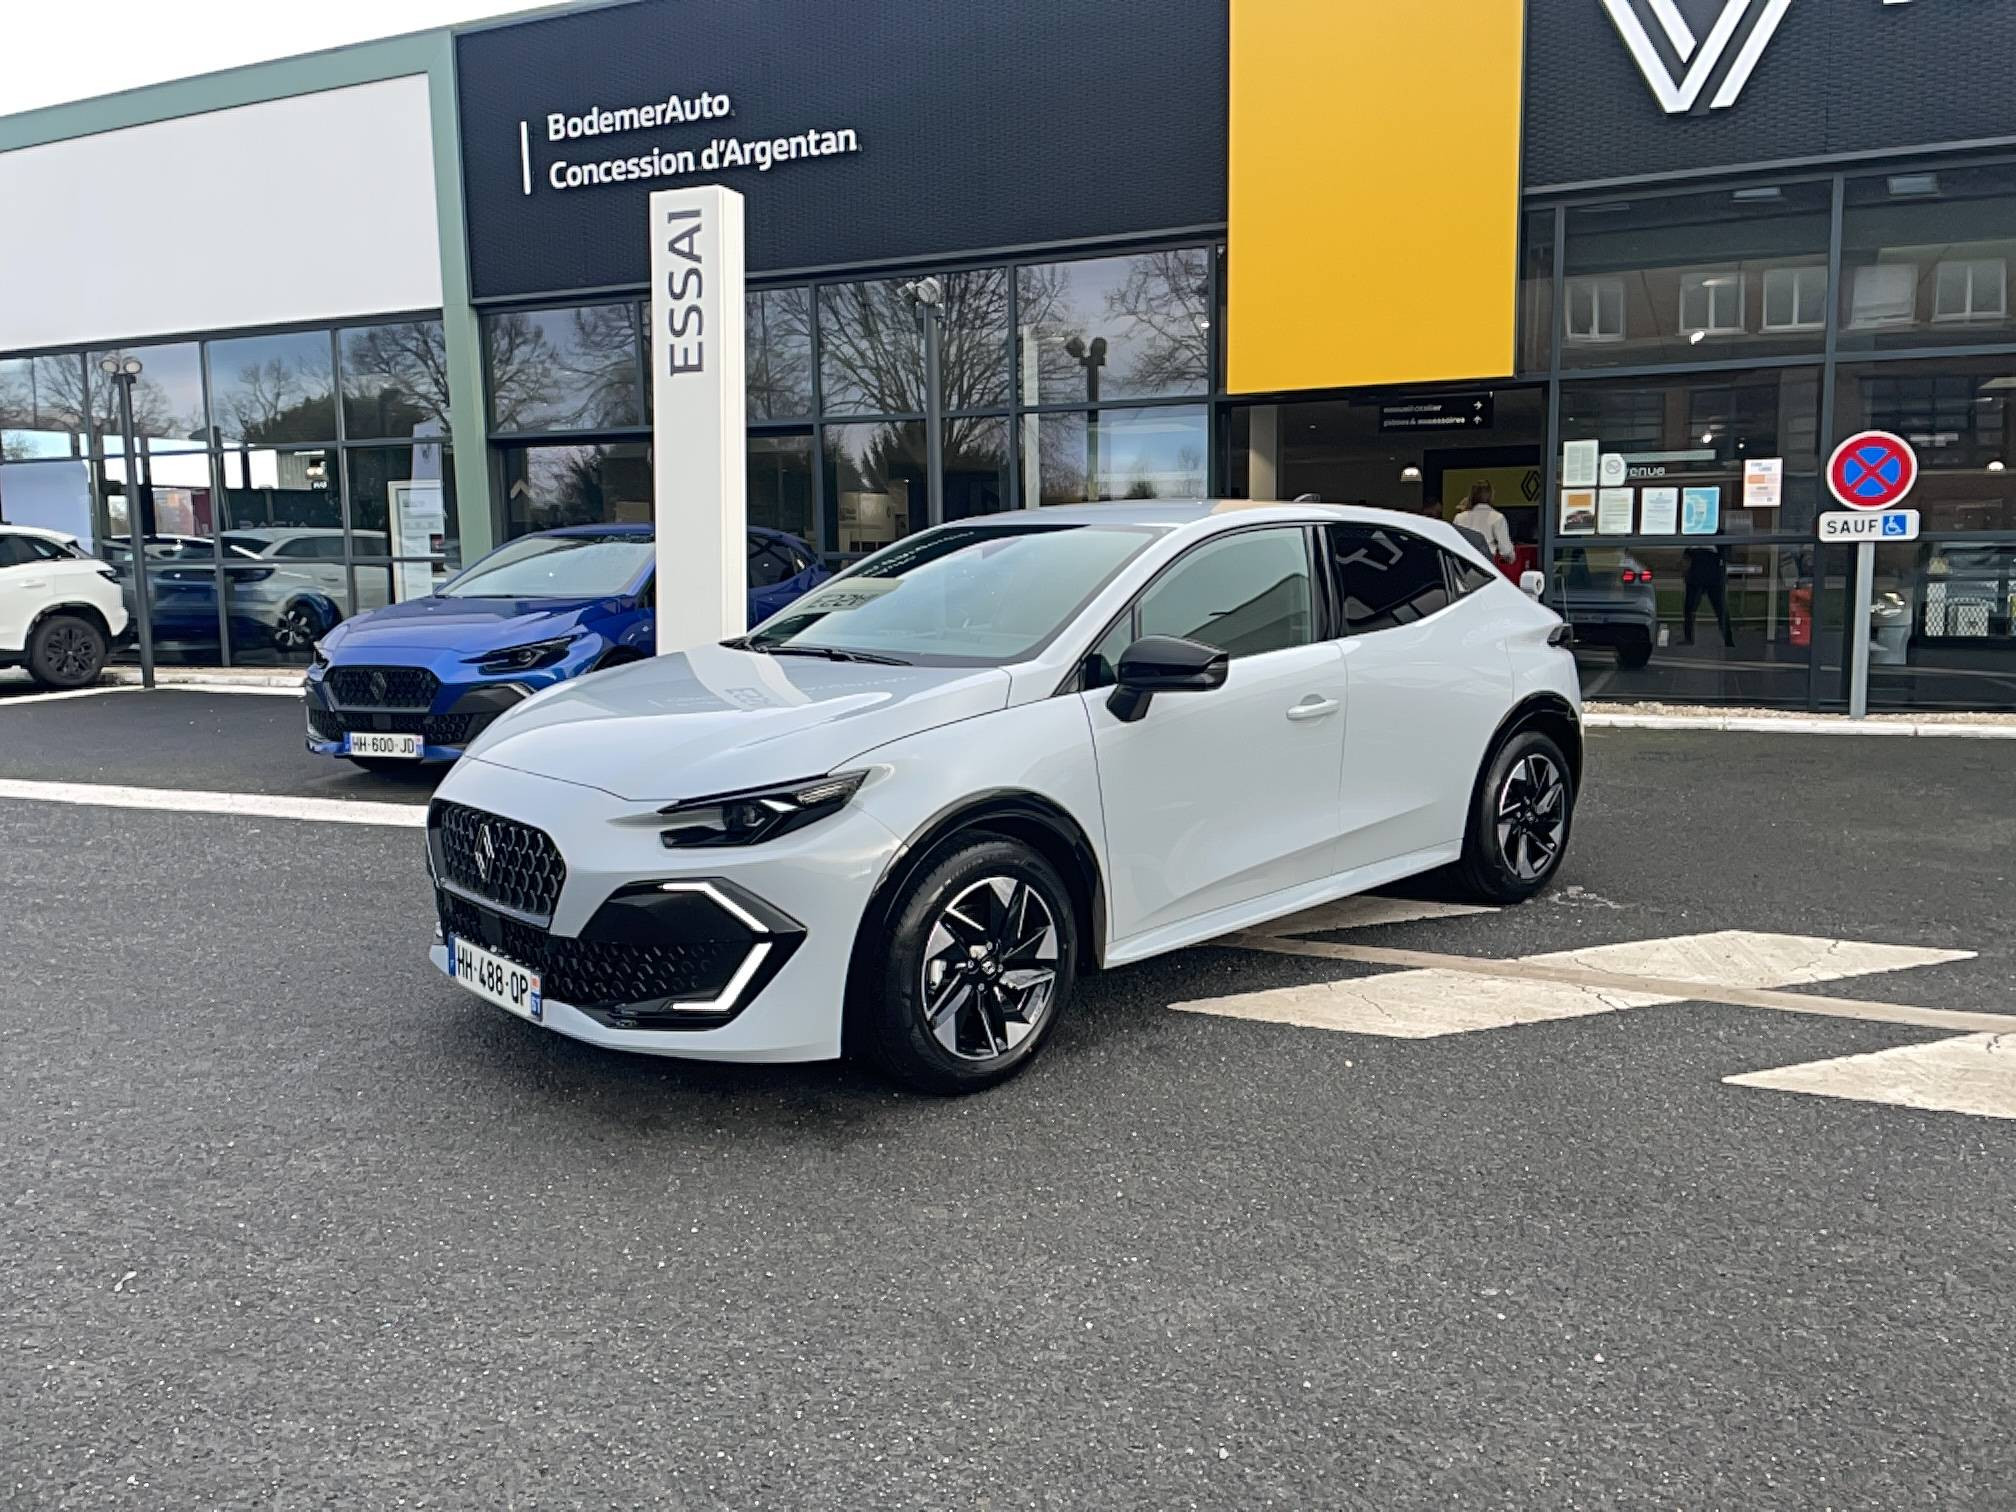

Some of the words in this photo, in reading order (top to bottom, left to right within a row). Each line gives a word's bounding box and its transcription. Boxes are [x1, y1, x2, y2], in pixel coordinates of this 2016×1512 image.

[547, 91, 730, 141] BodemerAuto
[549, 147, 695, 189] Concession
[700, 128, 857, 171] d'Argentan
[667, 208, 704, 377] ESSAI
[1826, 519, 1878, 534] SAUF
